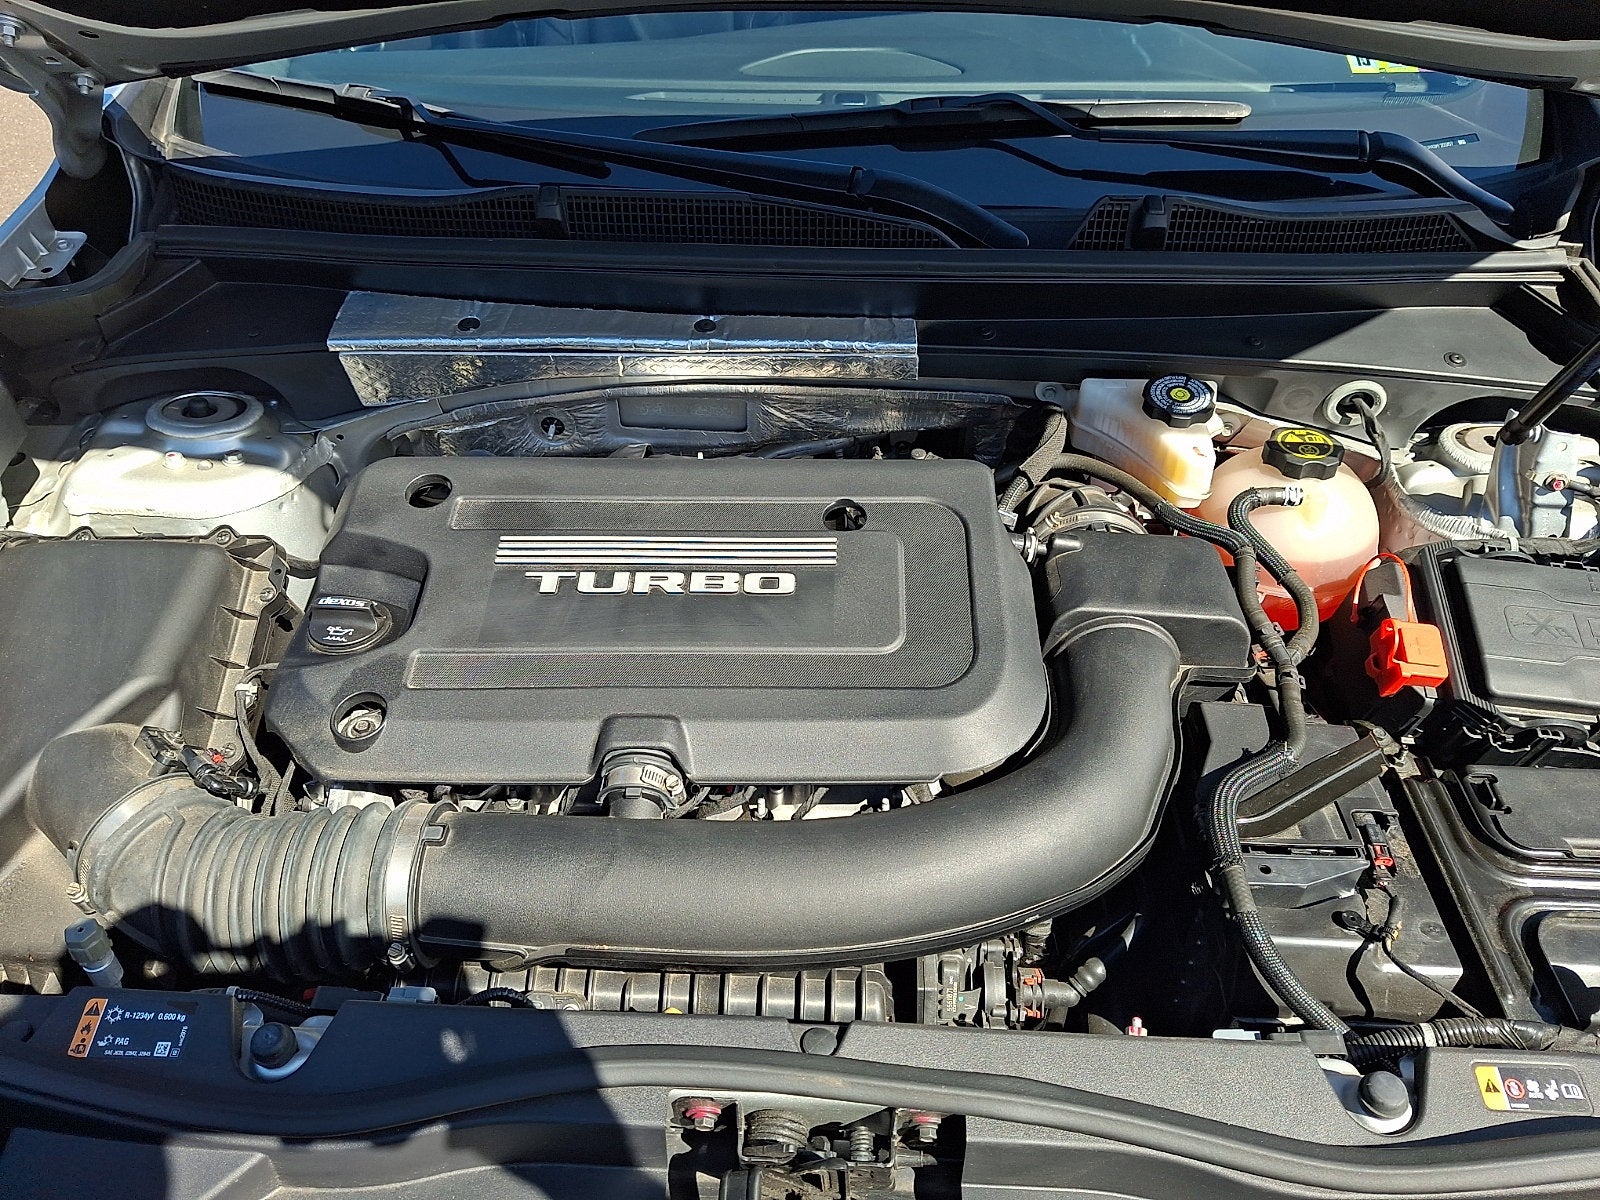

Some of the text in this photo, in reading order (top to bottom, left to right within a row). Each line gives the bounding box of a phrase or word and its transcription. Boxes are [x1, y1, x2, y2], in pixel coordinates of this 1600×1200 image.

[525, 571, 796, 595] TURBO
[317, 596, 368, 607] dexos
[124, 1011, 186, 1022] R-1234yf 0.600 kg
[114, 1037, 130, 1045] PAG
